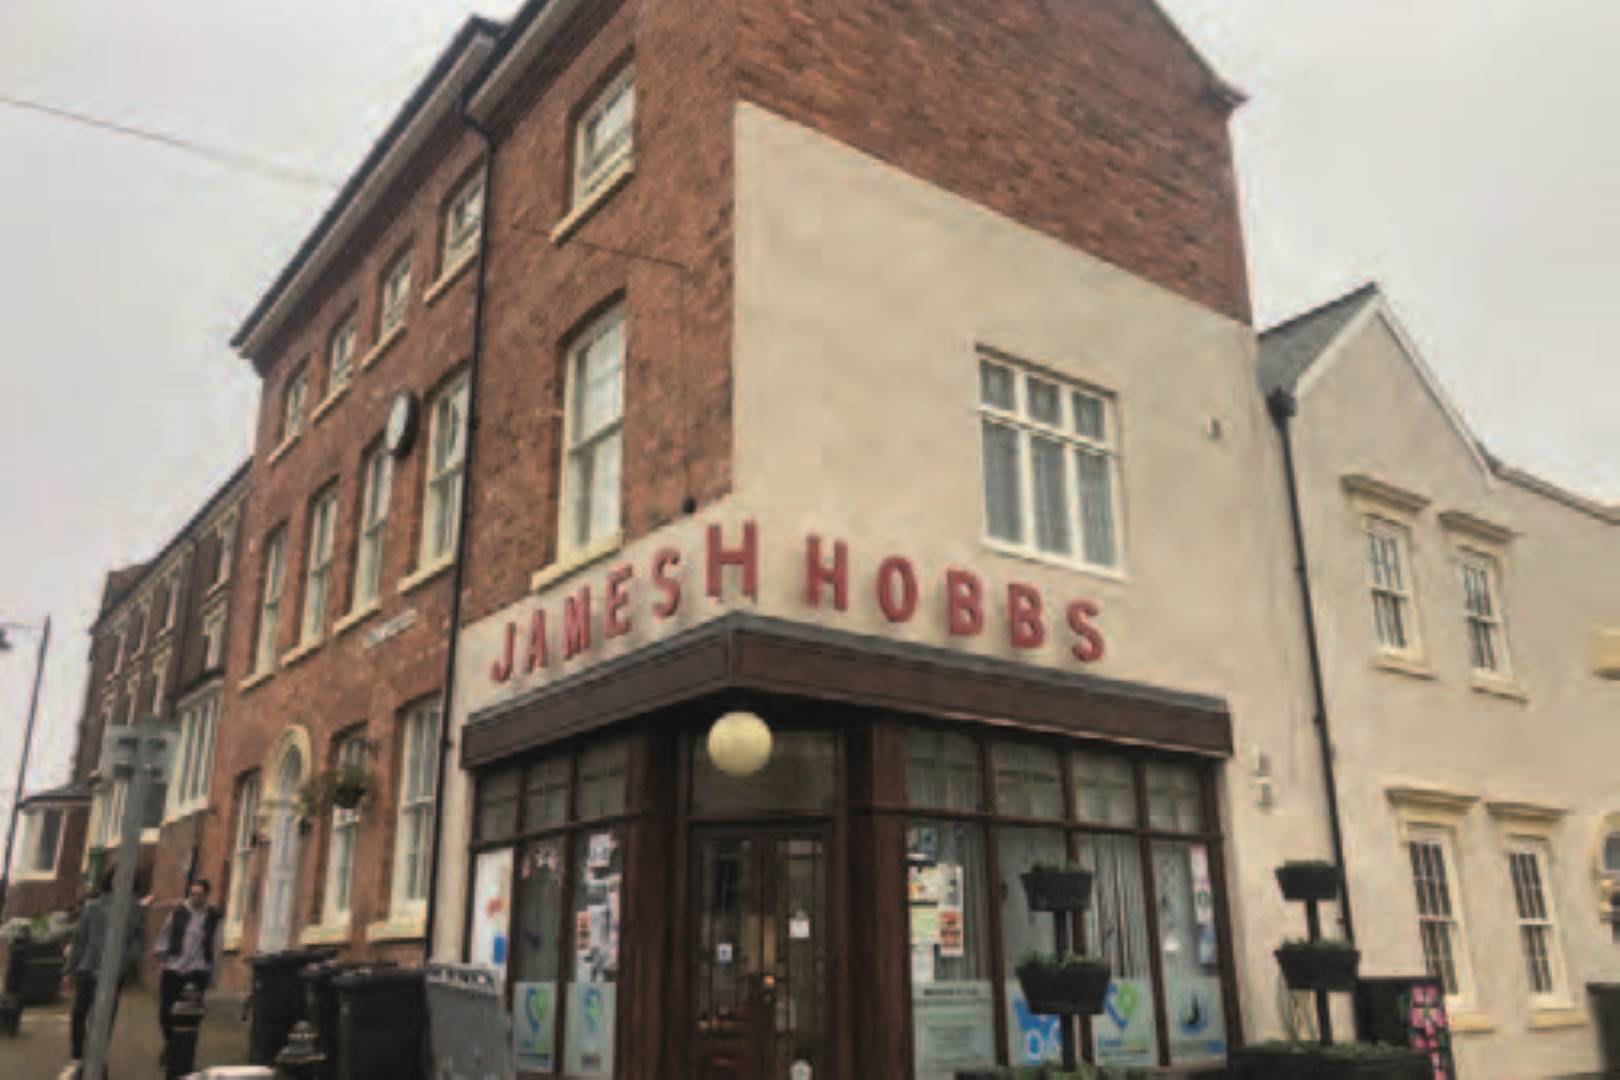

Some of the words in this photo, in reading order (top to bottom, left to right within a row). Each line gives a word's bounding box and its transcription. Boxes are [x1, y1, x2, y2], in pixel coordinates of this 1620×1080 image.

[491, 548, 682, 682] JAMES
[706, 519, 758, 600] H
[804, 534, 1105, 662] HOBBS
